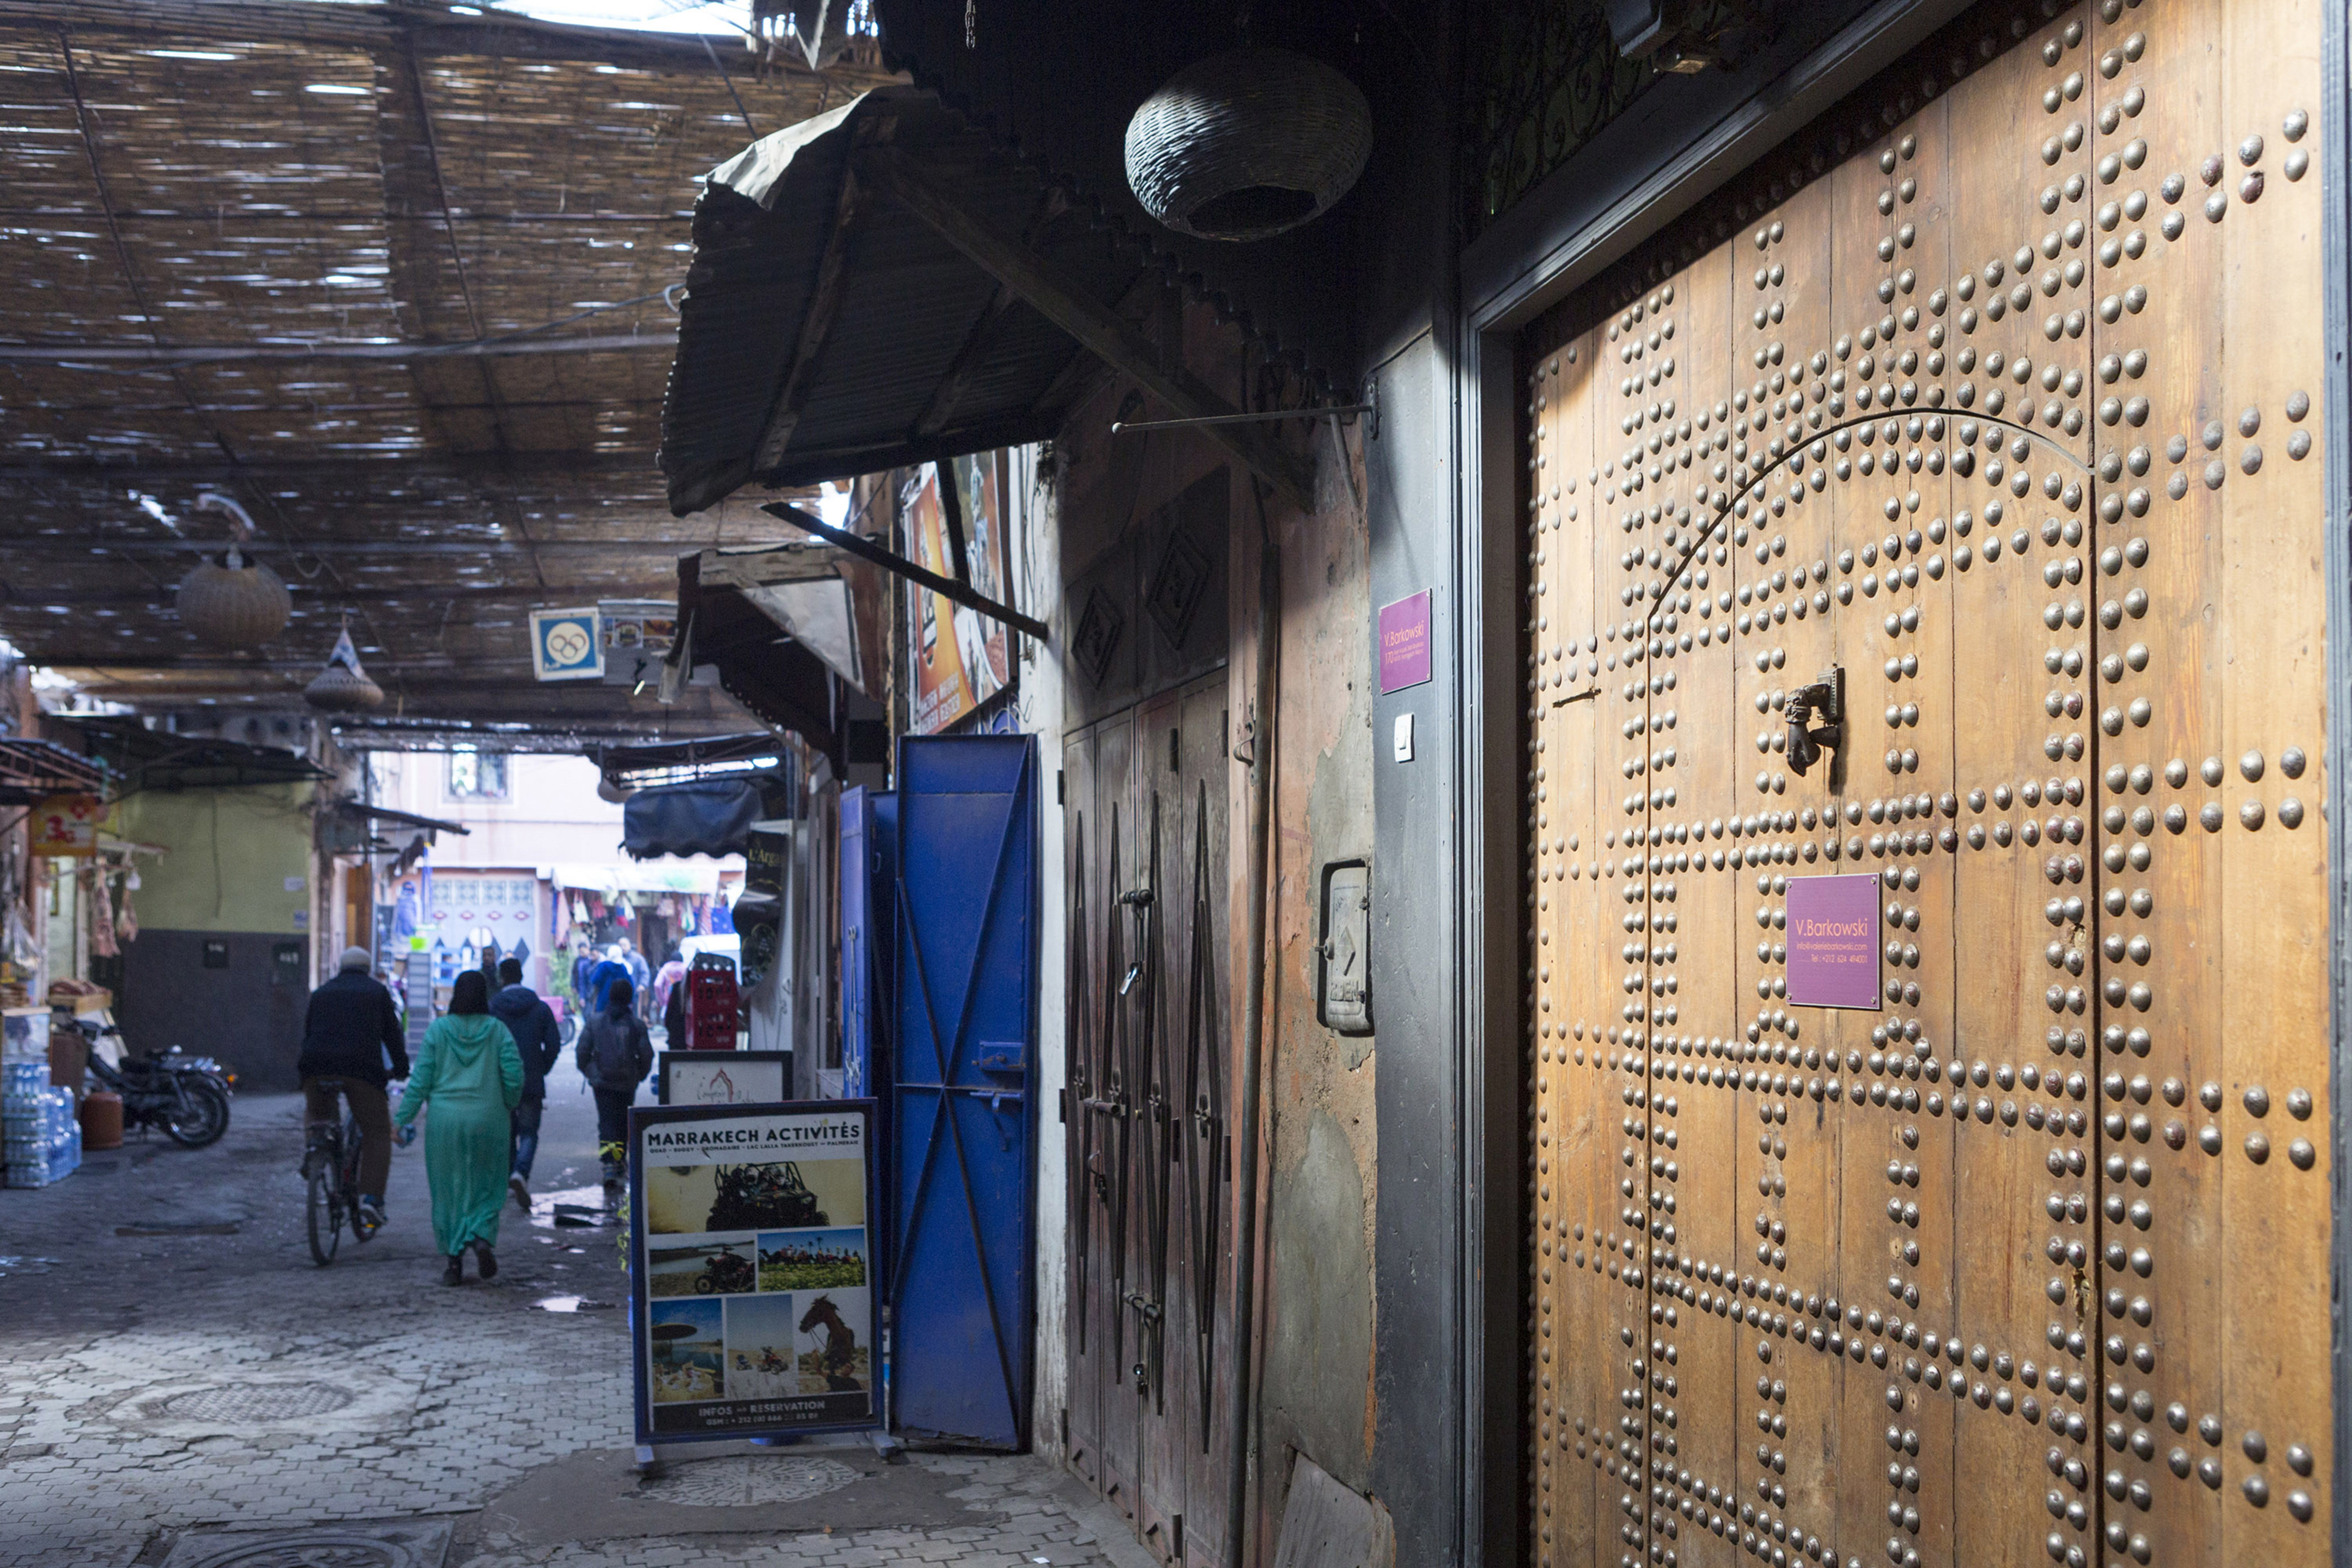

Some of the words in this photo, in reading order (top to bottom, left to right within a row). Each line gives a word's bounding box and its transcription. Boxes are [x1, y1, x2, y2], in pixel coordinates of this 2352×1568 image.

[1384, 620, 1424, 647] V.Barkowski
[1795, 918, 1868, 936] V.Barkowski
[648, 1129, 758, 1146] MARRAKECH
[766, 1121, 860, 1141] ACTIVITÉS
[699, 1406, 733, 1417] INFOS
[750, 1401, 825, 1414] RESERVATION
